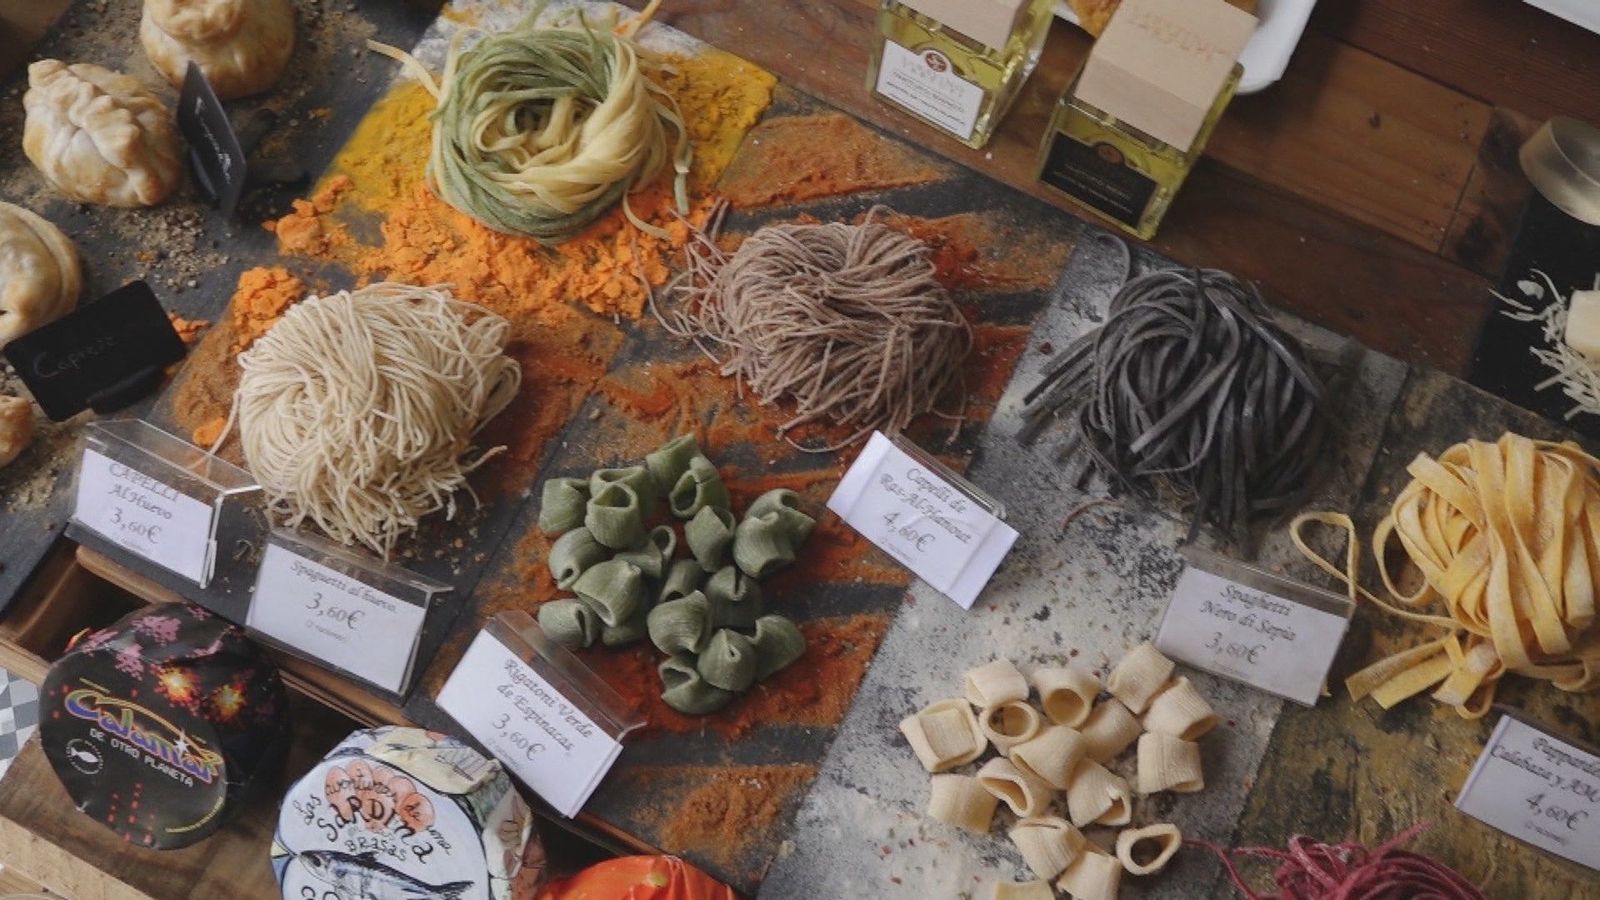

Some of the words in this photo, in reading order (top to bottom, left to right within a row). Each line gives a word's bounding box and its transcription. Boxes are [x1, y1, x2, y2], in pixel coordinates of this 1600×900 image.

[110, 507, 162, 544] 3,60€
[882, 512, 936, 552] 4,60€
[305, 592, 366, 629] 3,60€
[496, 683, 515, 699] de
[513, 694, 576, 752] Espinacas
[503, 658, 556, 708] Rigatoni
[557, 702, 594, 738] Verde
[89, 727, 105, 742] DE
[110, 738, 140, 760] OTRO
[143, 756, 194, 788] PLANETA
[492, 713, 546, 761] 3,60€
